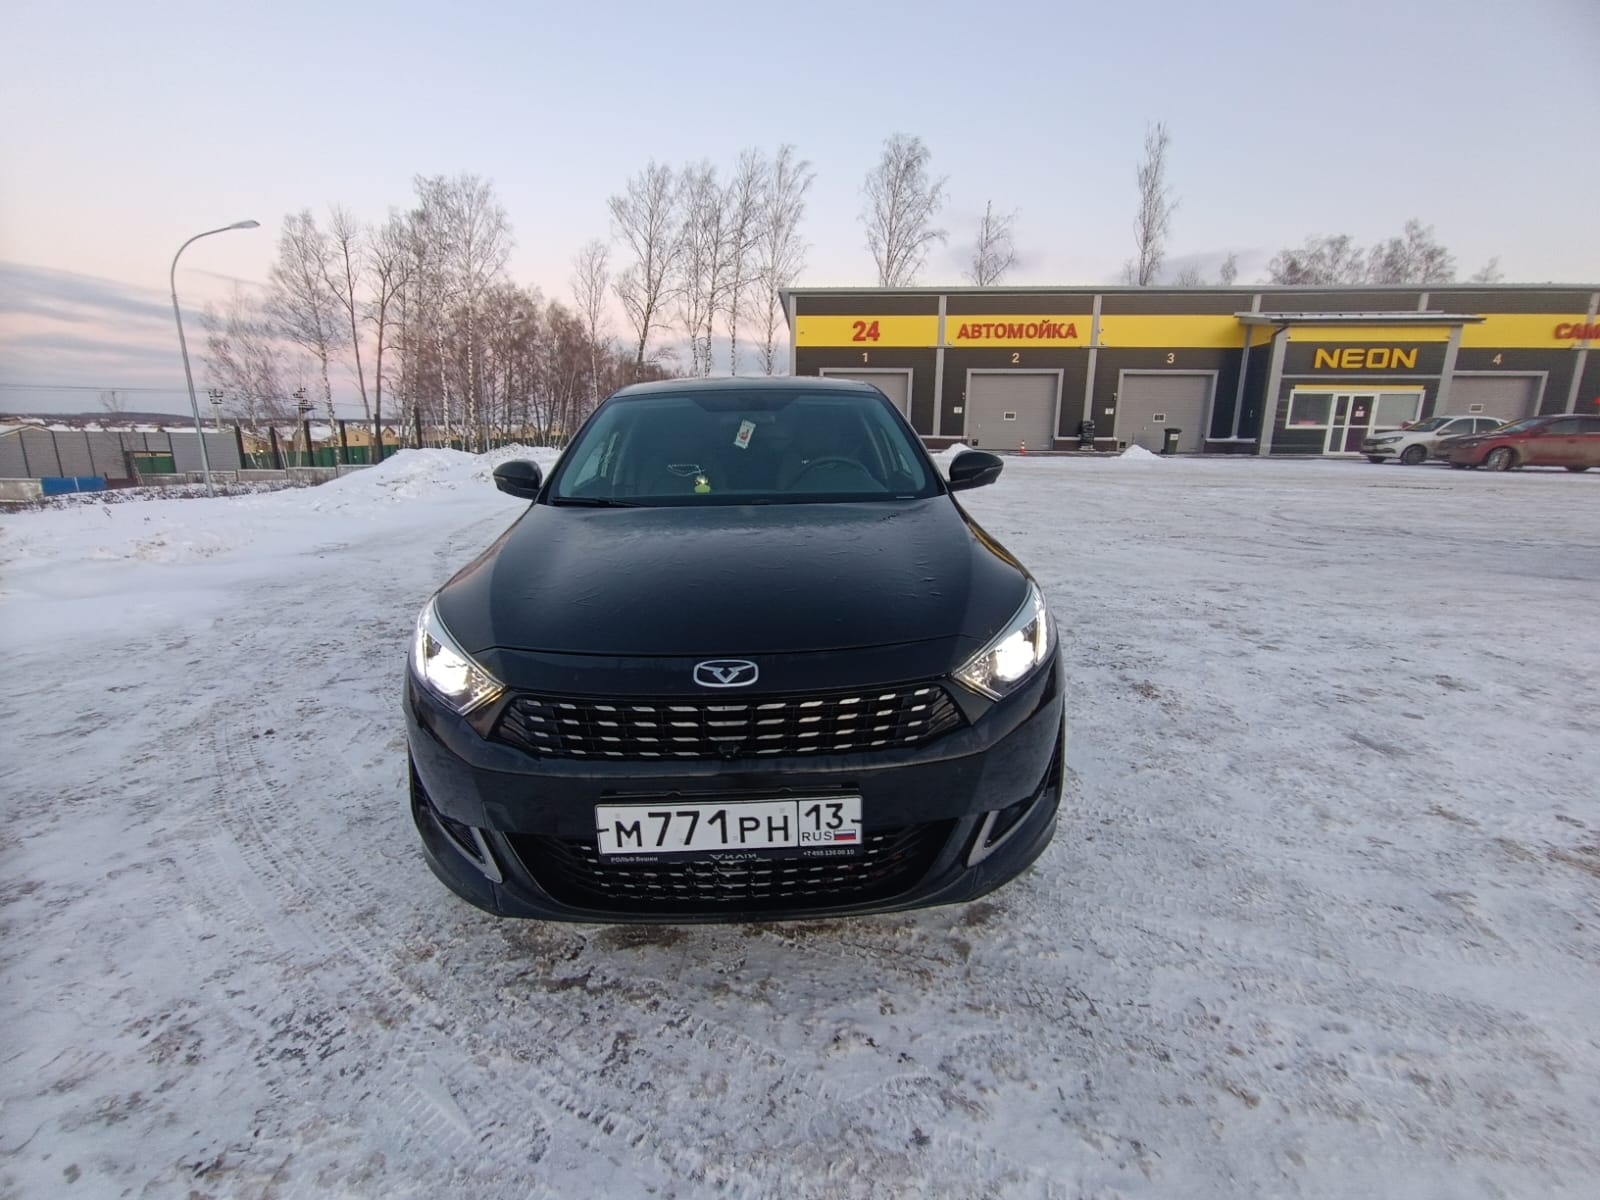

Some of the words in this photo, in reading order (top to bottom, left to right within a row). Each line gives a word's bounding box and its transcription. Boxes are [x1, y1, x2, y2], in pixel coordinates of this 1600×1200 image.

[852, 321, 880, 342] 24
[957, 320, 1078, 340] АВТОМОЙКА
[861, 352, 869, 363] 1
[1011, 353, 1020, 363] 2
[1166, 353, 1176, 364] 3
[1314, 348, 1418, 369] NEON
[1492, 353, 1502, 366] 4
[804, 802, 844, 831] 13
[615, 809, 790, 848] М771РН
[801, 830, 833, 842] RUS
